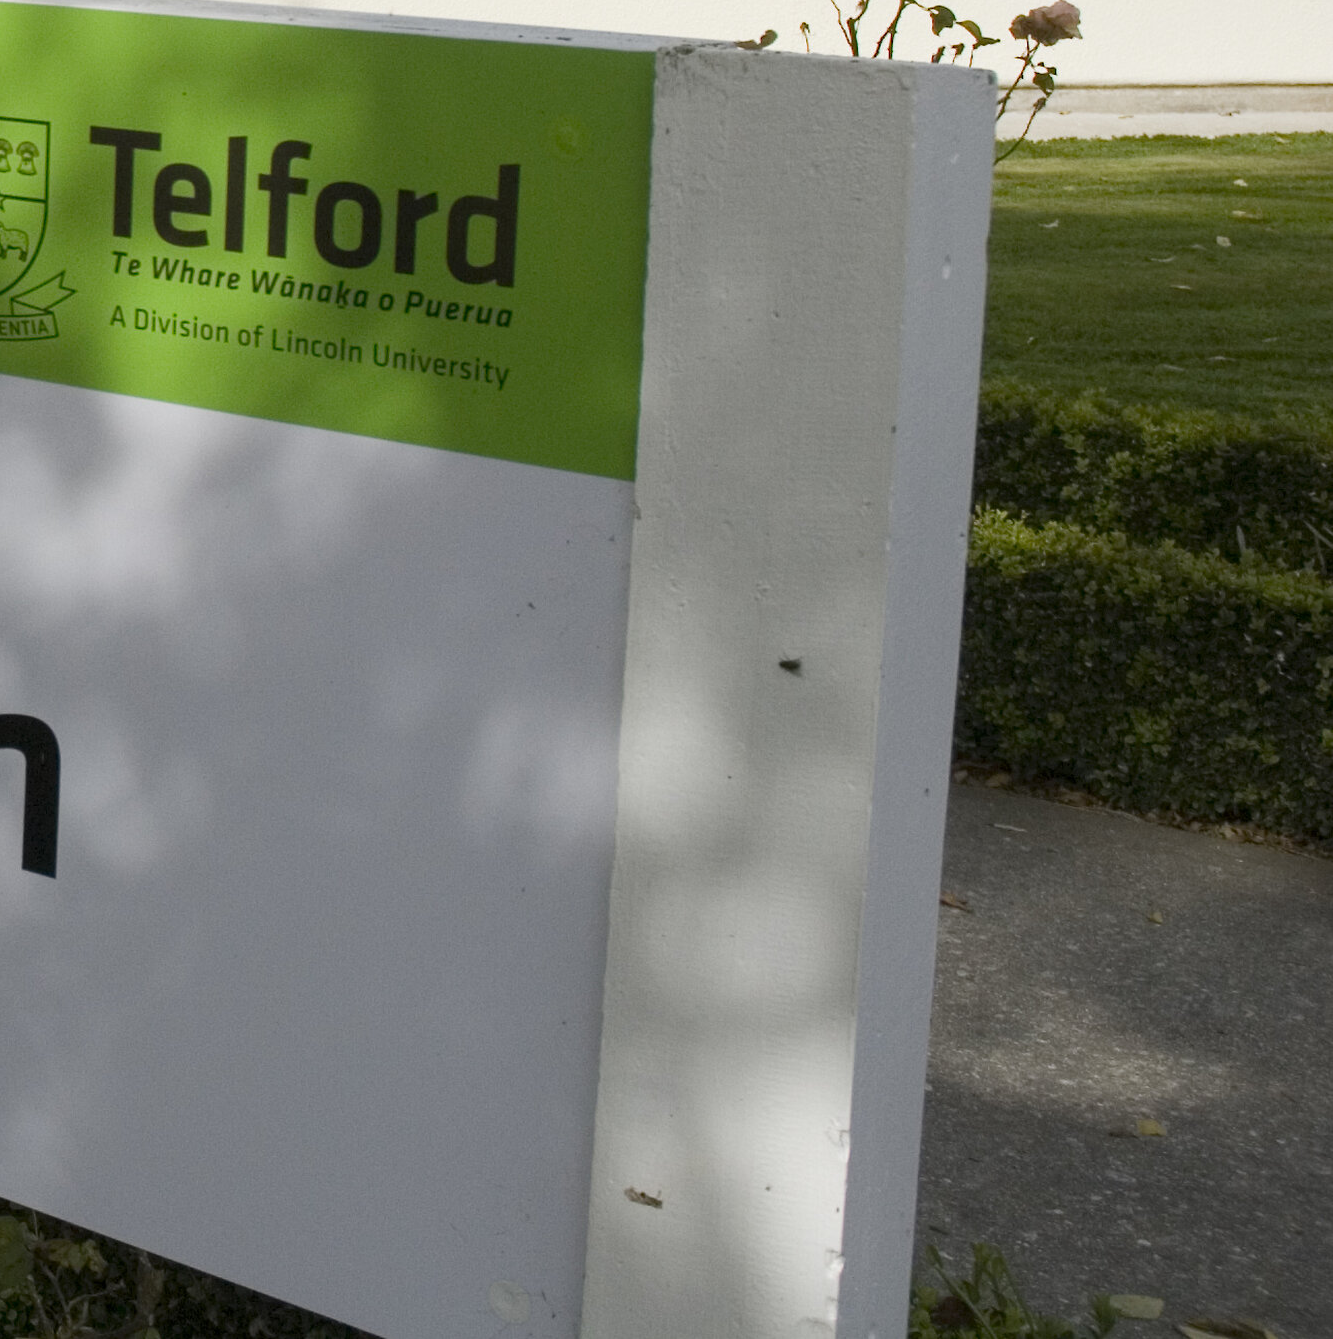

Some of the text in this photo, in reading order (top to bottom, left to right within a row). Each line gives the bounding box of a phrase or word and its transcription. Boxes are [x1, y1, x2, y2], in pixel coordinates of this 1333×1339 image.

[89, 125, 522, 289] Telford
[112, 250, 141, 277] Te
[152, 256, 241, 290] Whare
[378, 293, 395, 312] o
[404, 290, 513, 328] Puerua
[110, 305, 509, 391] A Division of Lincoln University
